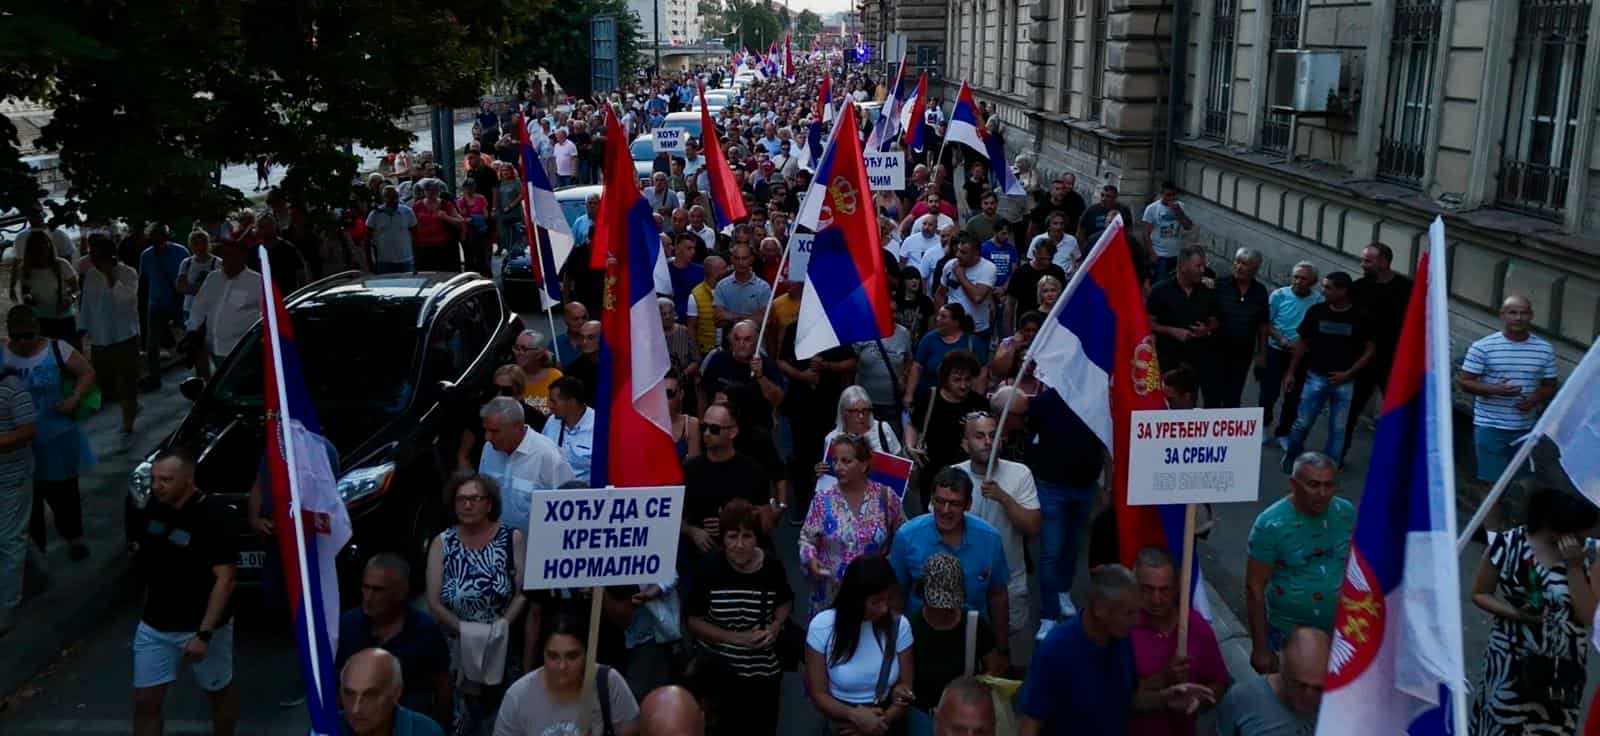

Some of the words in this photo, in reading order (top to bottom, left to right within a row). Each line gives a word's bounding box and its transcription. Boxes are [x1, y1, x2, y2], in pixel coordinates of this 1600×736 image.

[660, 140, 678, 148] МИР
[885, 156, 899, 169] ДА
[869, 175, 891, 185] ЧИМ
[1137, 422, 1153, 439] ЗА
[1155, 420, 1210, 439] УРЕЂЕНУ
[1212, 419, 1257, 437] СРБИЈУ
[1164, 447, 1180, 464] ЗА
[1183, 446, 1228, 464] СРБИЈУ
[544, 499, 605, 522] ХОЋУ
[609, 498, 639, 523] ДА
[646, 497, 672, 518] СЕ
[562, 527, 649, 550] КРЕЋЕМ
[543, 554, 661, 579] НОРМАЛНО
